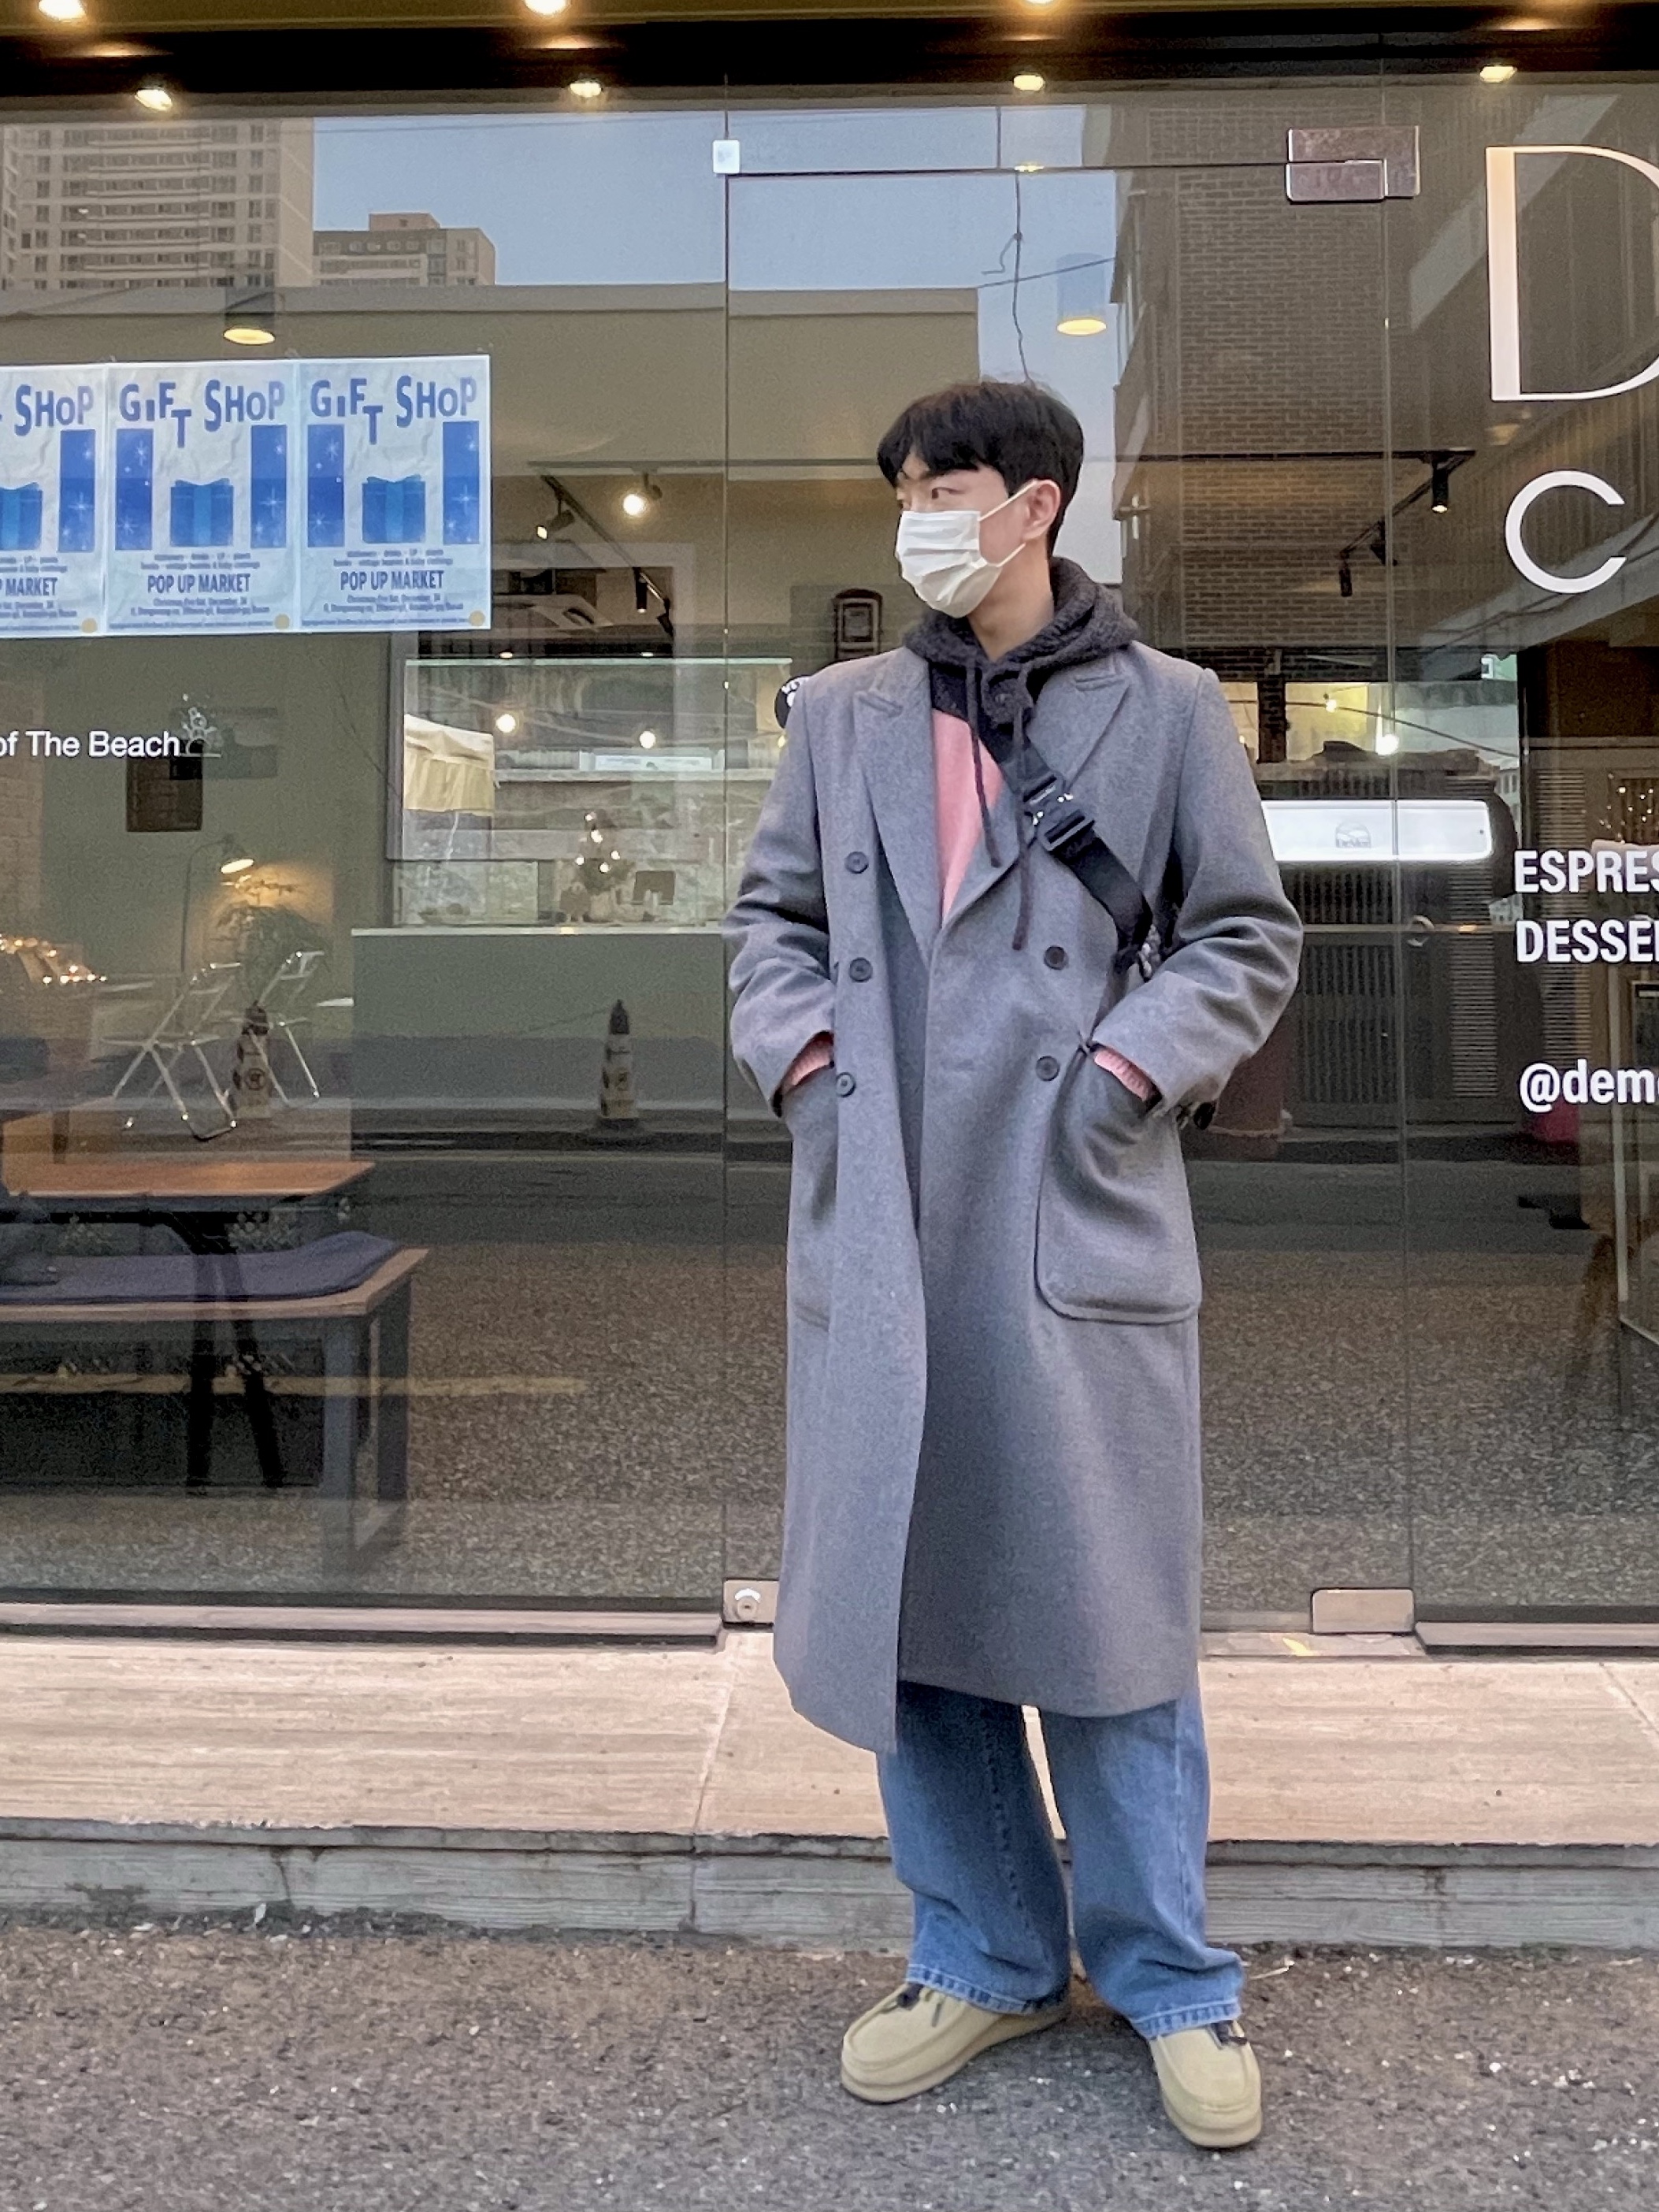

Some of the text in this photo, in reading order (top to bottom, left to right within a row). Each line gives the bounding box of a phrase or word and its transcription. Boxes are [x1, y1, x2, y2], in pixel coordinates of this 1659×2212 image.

[1486, 146, 1659, 401] D
[6, 577, 58, 596] MARKET
[147, 573, 251, 594] POP UP MARKET
[340, 570, 445, 591] POP UP MARKET
[24, 730, 80, 757] The
[89, 730, 180, 757] Beach
[1516, 919, 1659, 963] DESSE
[1520, 1059, 1659, 1113] @dem
